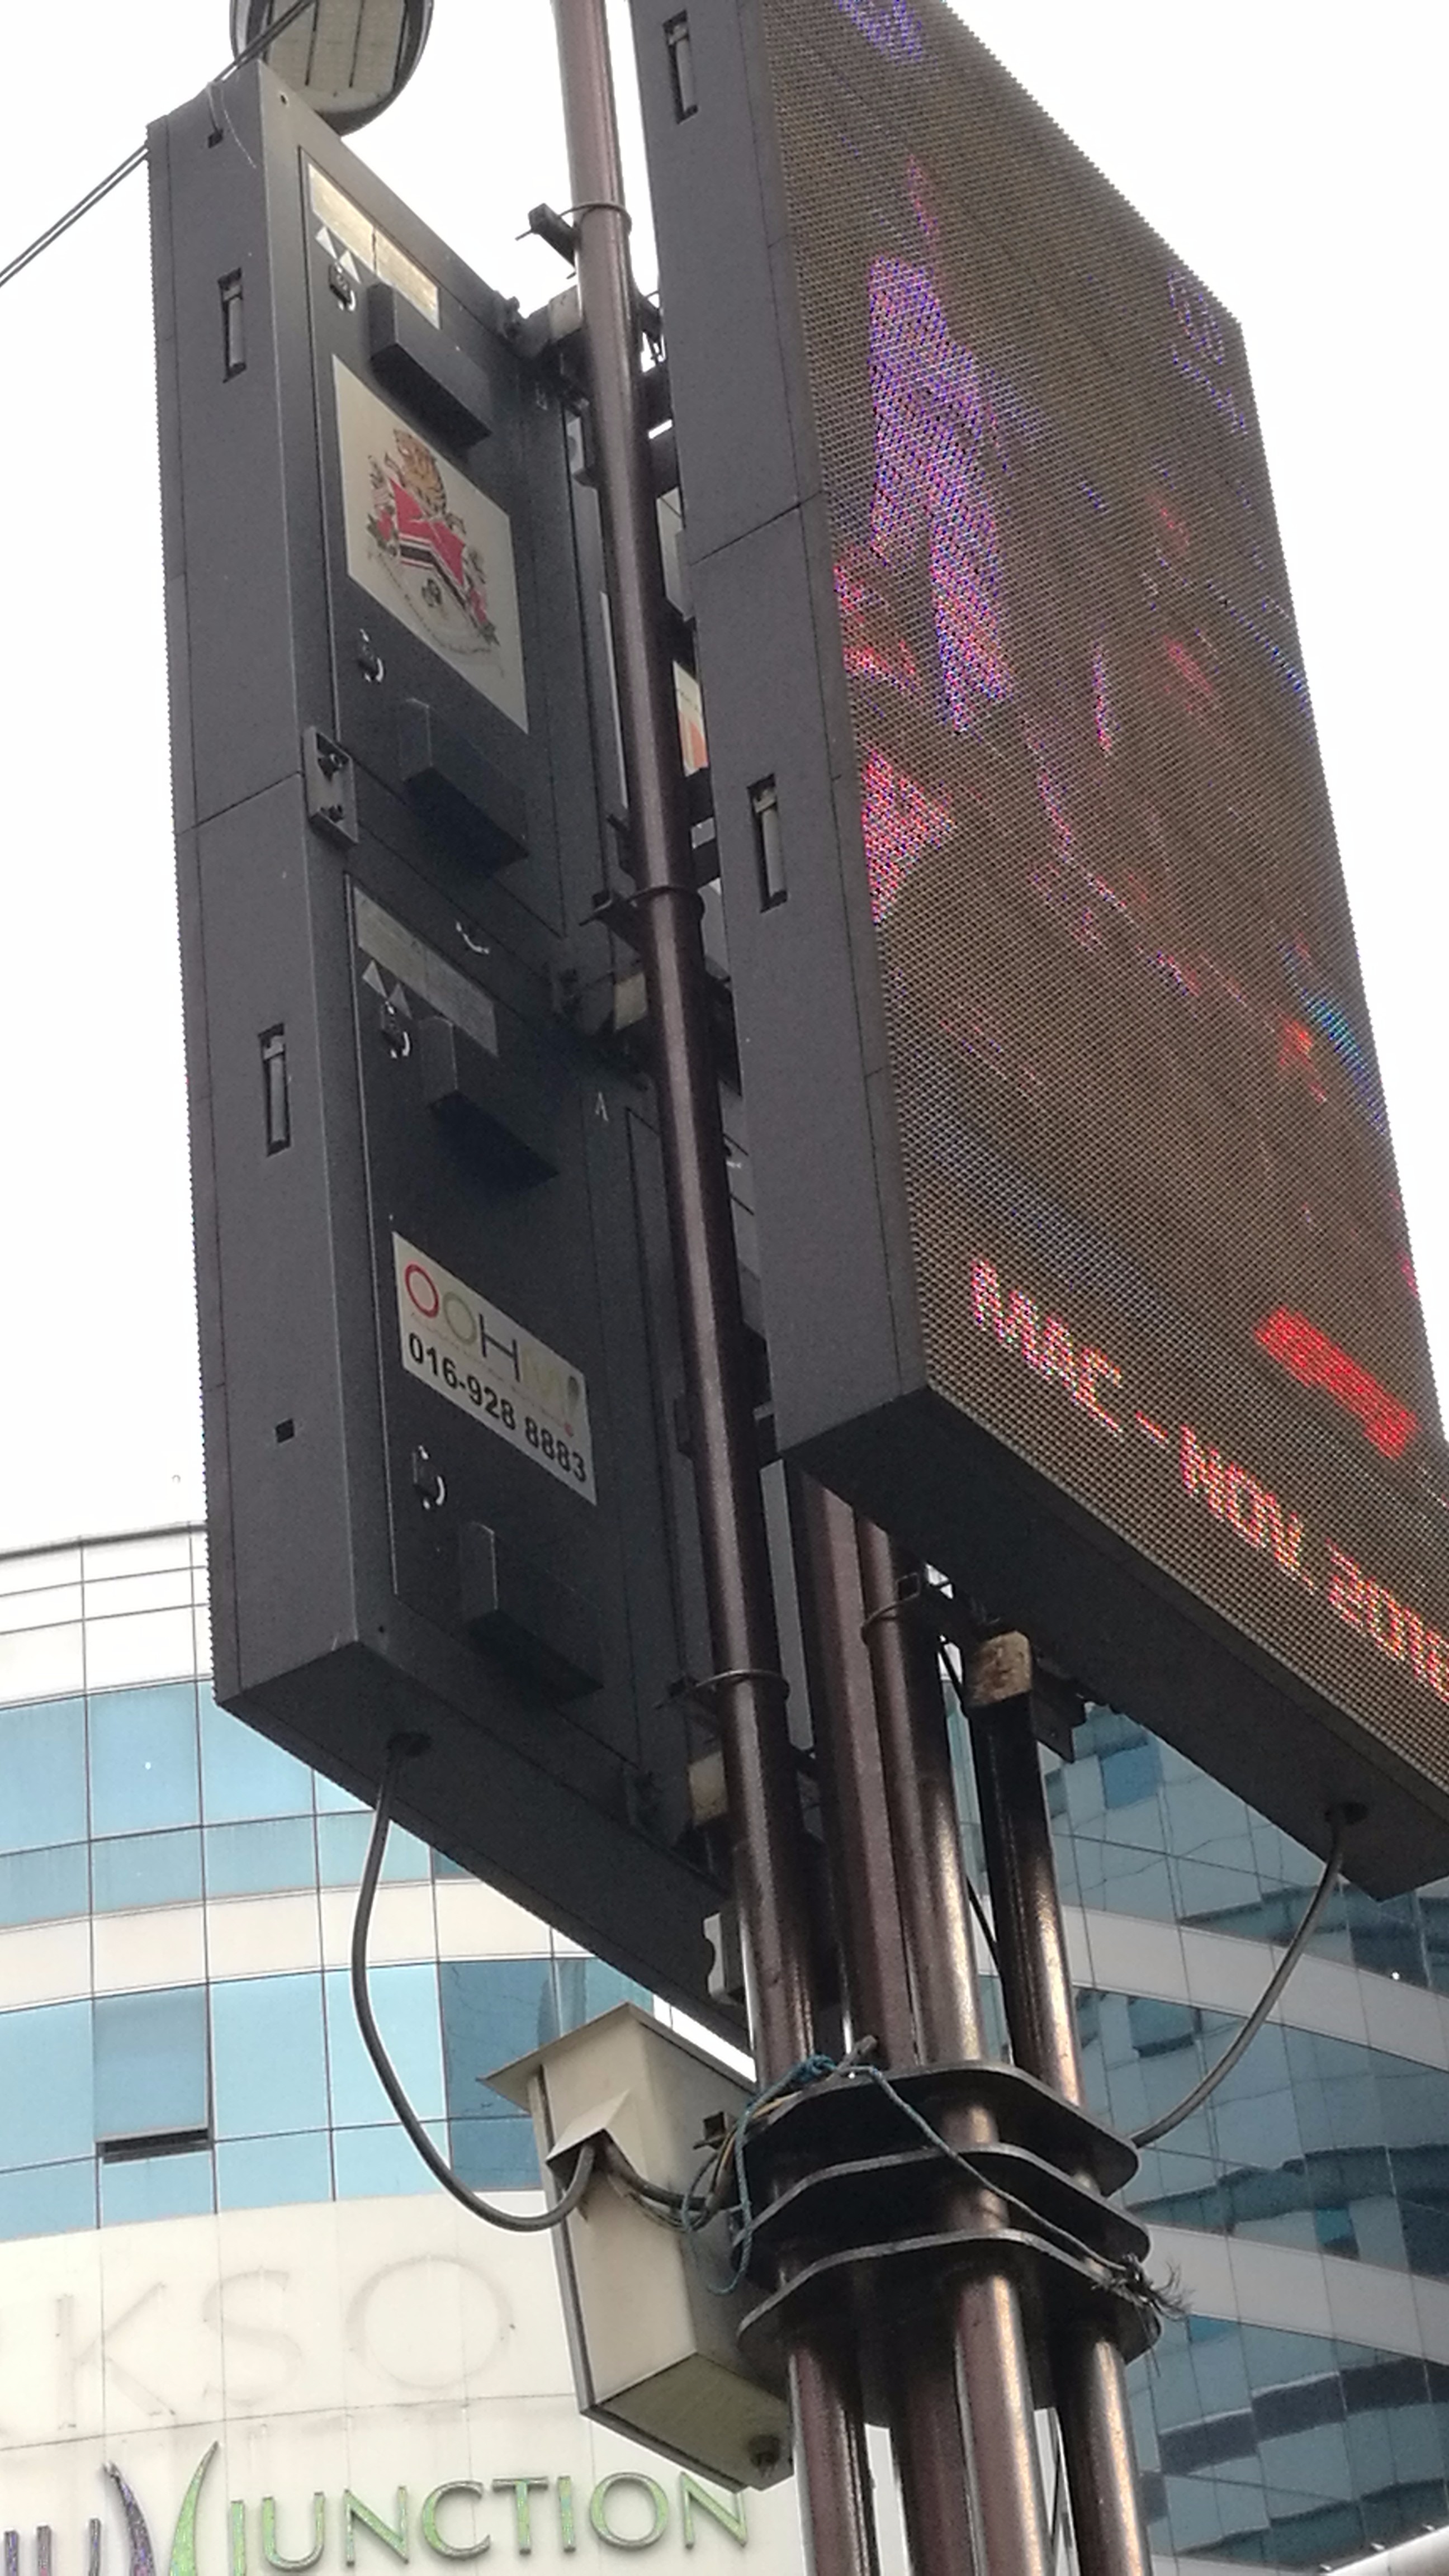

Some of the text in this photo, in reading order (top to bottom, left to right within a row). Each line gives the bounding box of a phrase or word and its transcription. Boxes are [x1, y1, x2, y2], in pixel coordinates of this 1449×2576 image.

[409, 1333, 515, 1430] 016-928
[525, 1417, 586, 1482] 8883
[230, 2470, 747, 2576] JUNCTION
